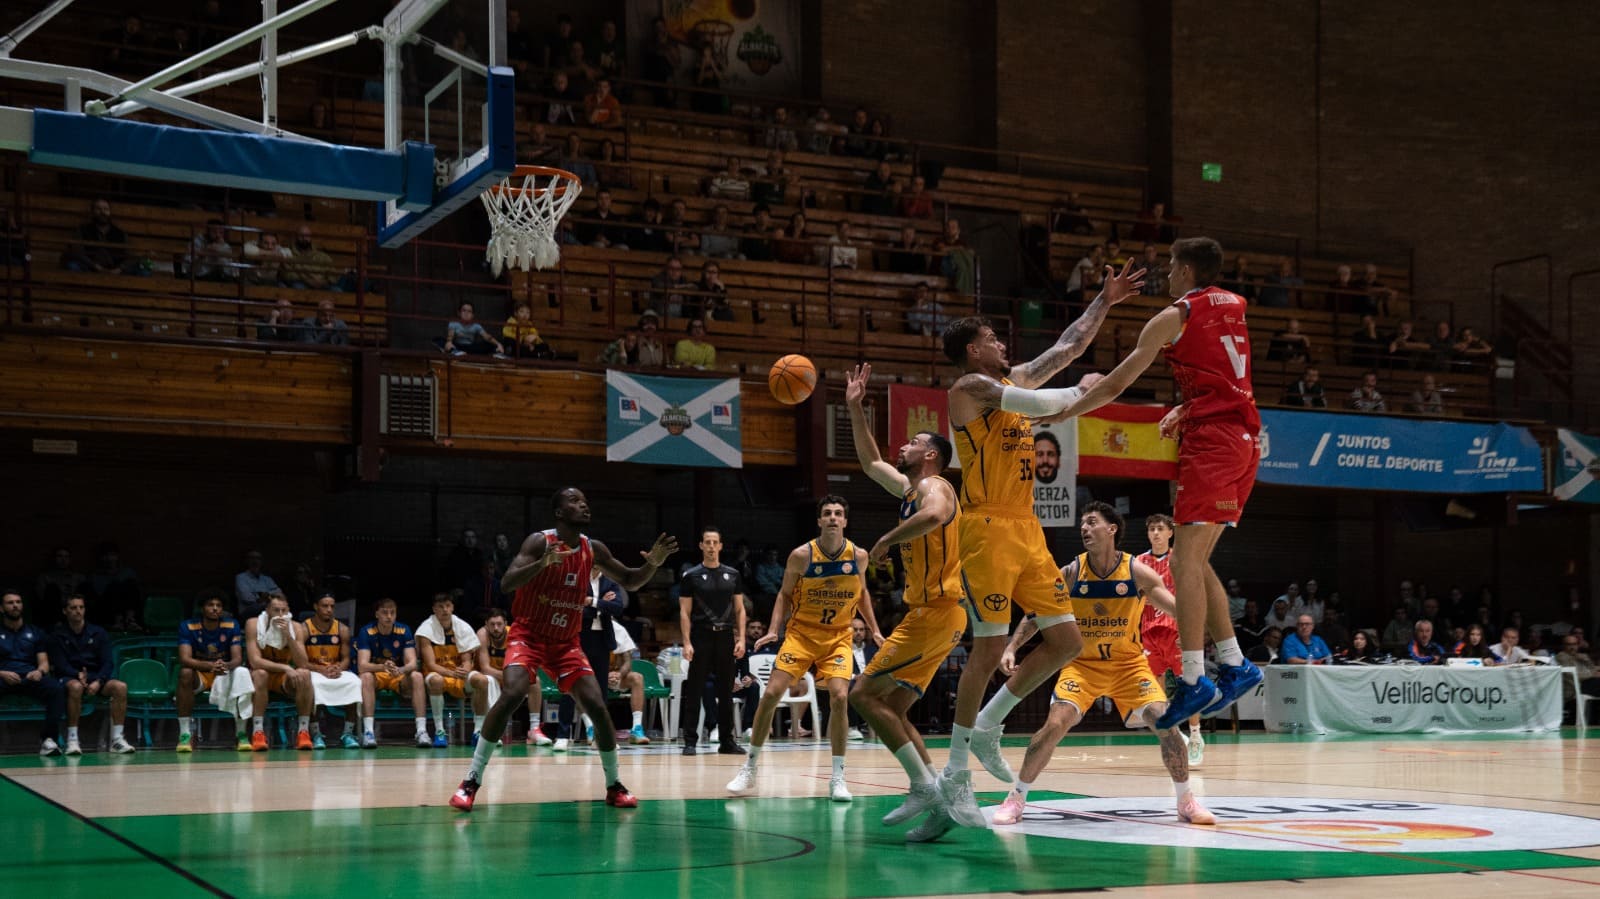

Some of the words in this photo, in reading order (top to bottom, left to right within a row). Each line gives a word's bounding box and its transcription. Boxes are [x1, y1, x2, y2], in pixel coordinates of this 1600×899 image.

[1336, 434, 1391, 450] JUNTOS
[1019, 458, 1033, 481] 35
[1337, 453, 1364, 468] CON
[1366, 455, 1383, 469] EL
[1384, 457, 1443, 472] DEPORTE
[1033, 487, 1070, 501] UERZA
[550, 612, 568, 628] 66
[820, 608, 837, 624] 12
